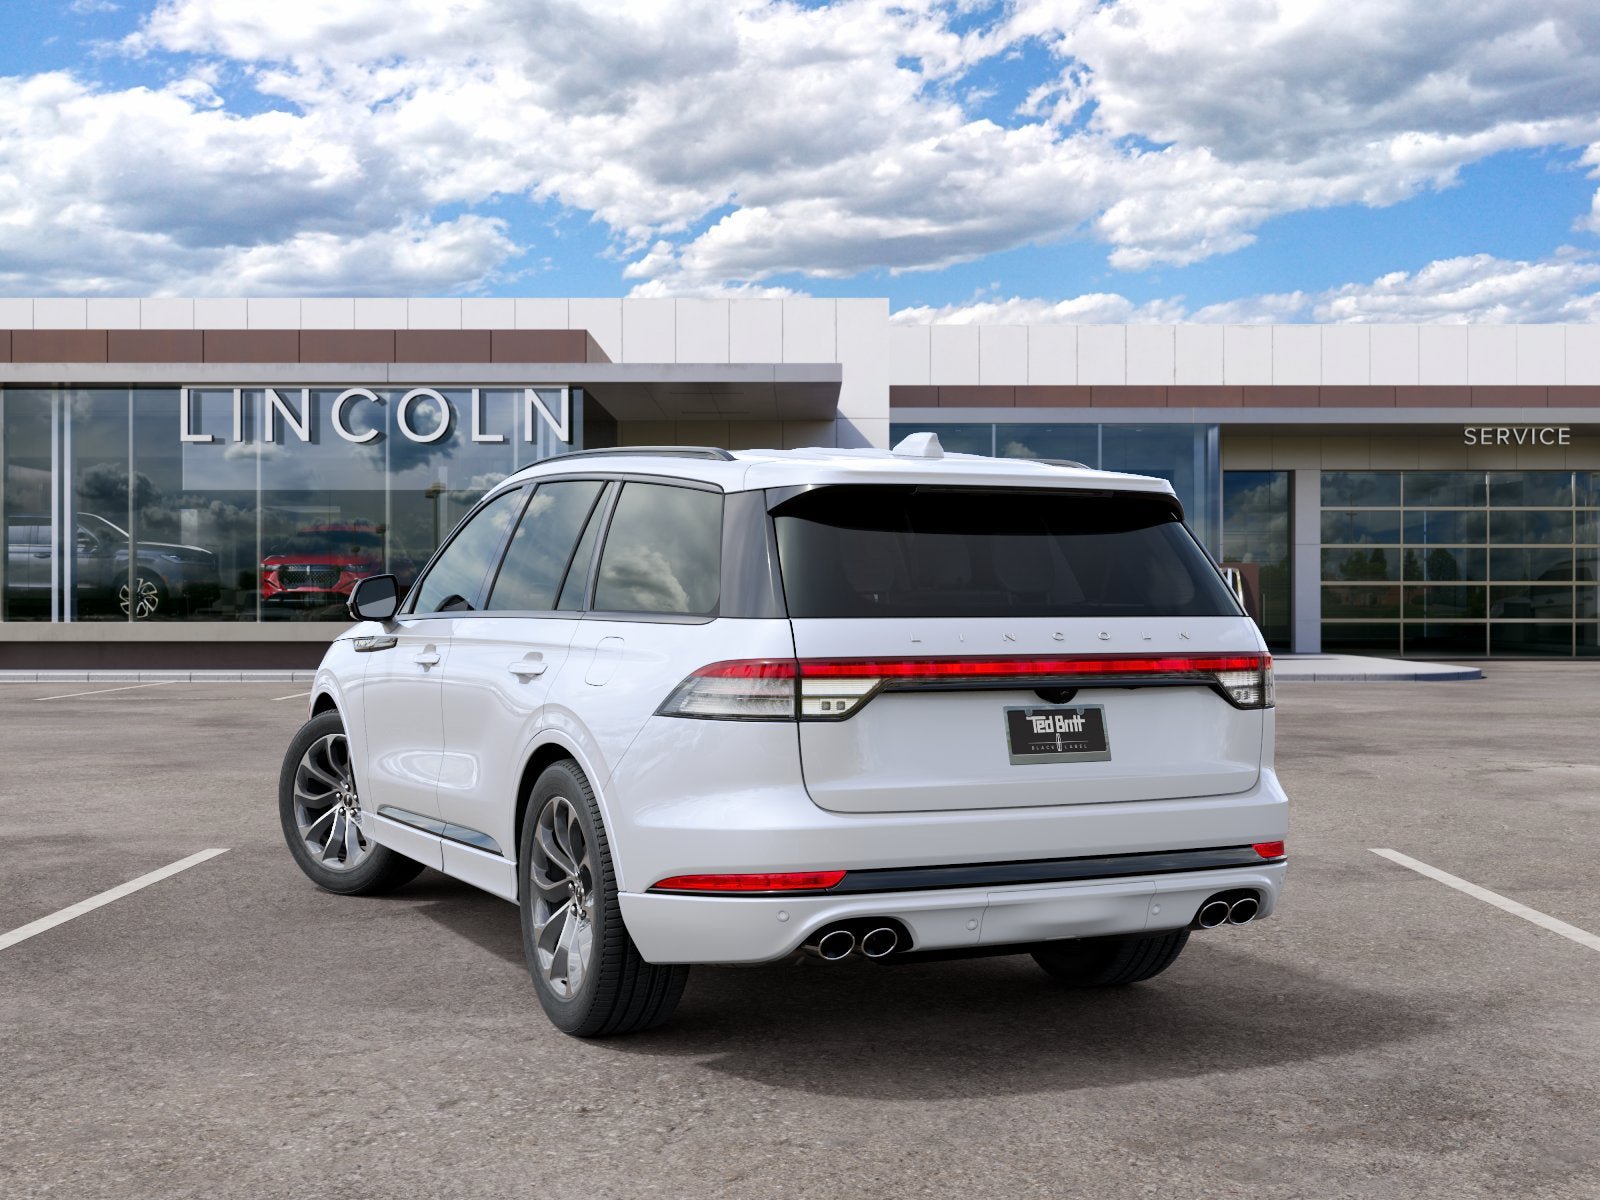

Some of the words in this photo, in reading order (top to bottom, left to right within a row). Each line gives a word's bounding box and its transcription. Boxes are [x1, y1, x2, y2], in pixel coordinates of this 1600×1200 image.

[180, 388, 570, 443] LINCOLN
[1464, 427, 1571, 445] SERVICE
[909, 630, 1191, 643] LINCOLN
[1026, 715, 1055, 733] Ted
[1055, 714, 1086, 733] Britt
